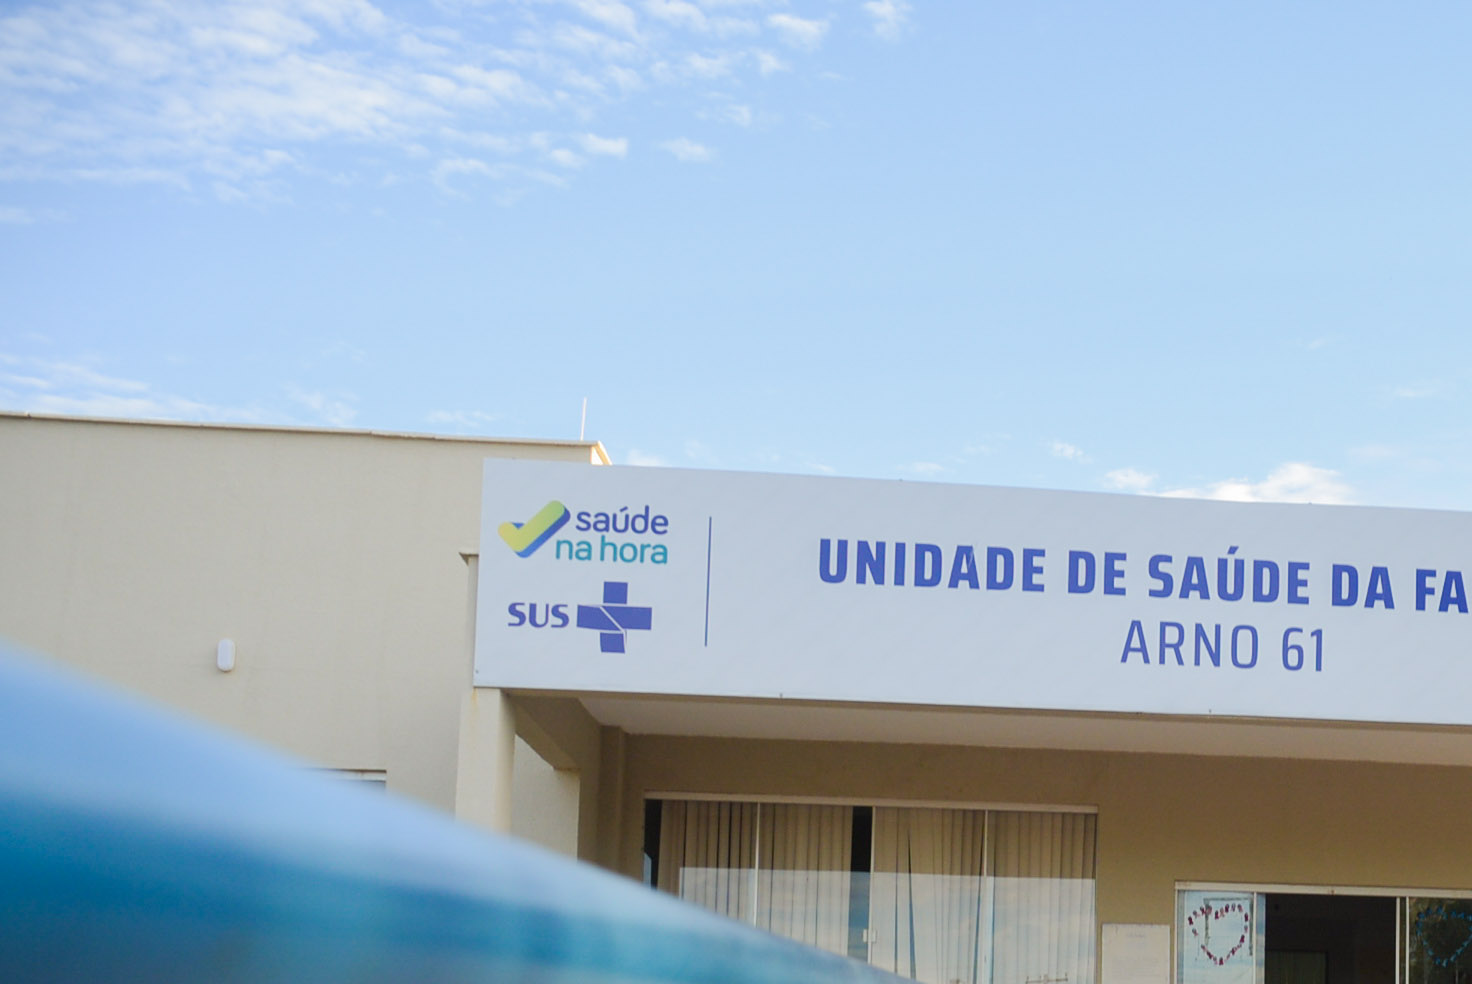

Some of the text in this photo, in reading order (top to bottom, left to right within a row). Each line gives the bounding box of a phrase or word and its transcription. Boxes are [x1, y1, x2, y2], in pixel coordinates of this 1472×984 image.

[575, 504, 669, 535] saúde
[555, 535, 668, 564] na hora
[818, 538, 1046, 592] UNIDADE
[1067, 550, 1128, 596] DE
[1147, 546, 1310, 606] SAÚDE
[1331, 564, 1395, 610] DA
[507, 602, 570, 628] SUS
[1120, 620, 1326, 672] ARNO 61
